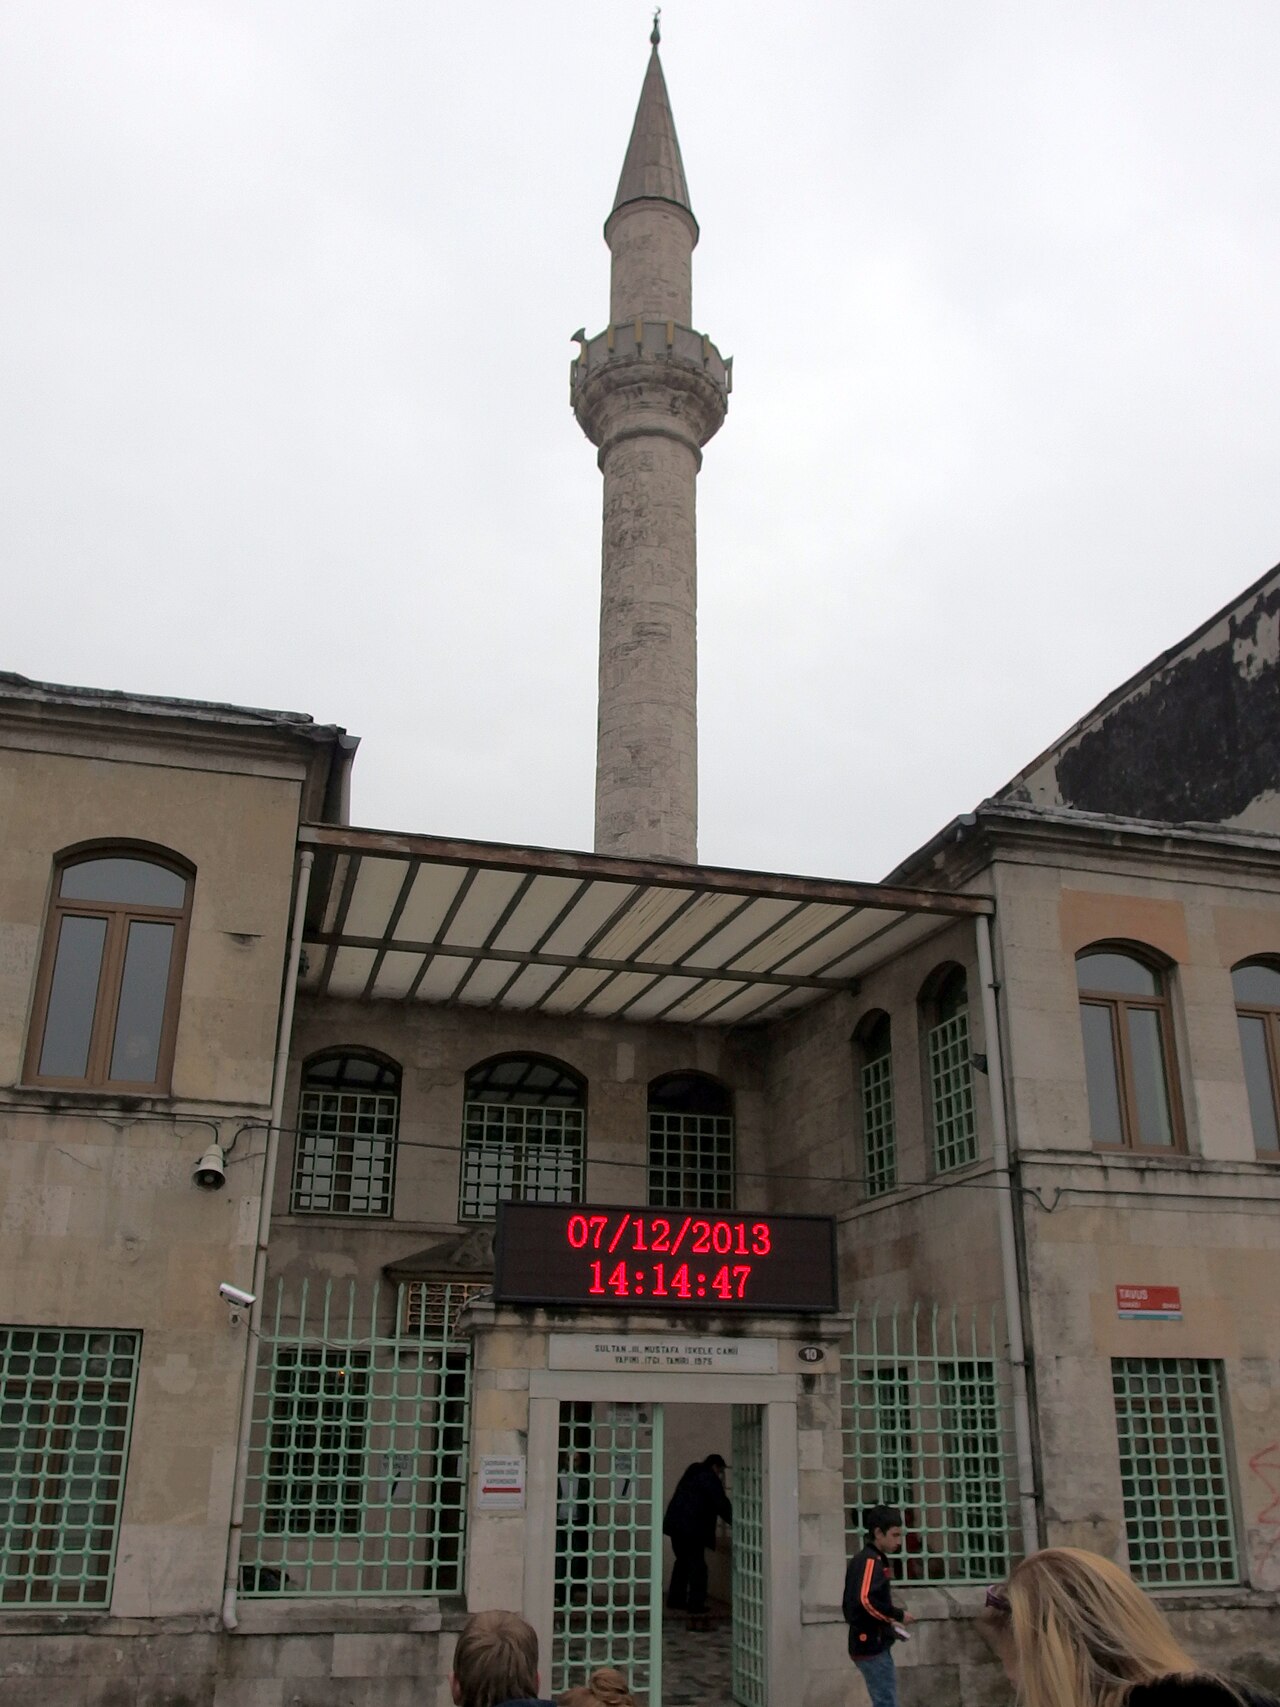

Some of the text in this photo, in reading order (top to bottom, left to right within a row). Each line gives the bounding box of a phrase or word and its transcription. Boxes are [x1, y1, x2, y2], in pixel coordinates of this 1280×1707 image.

[567, 1214, 772, 1255] 07/12/2013
[589, 1261, 752, 1299] 14:14:47
[595, 1344, 626, 1353] SULTAN
[644, 1346, 679, 1354] MUSTAFA
[805, 1349, 817, 1360] 10
